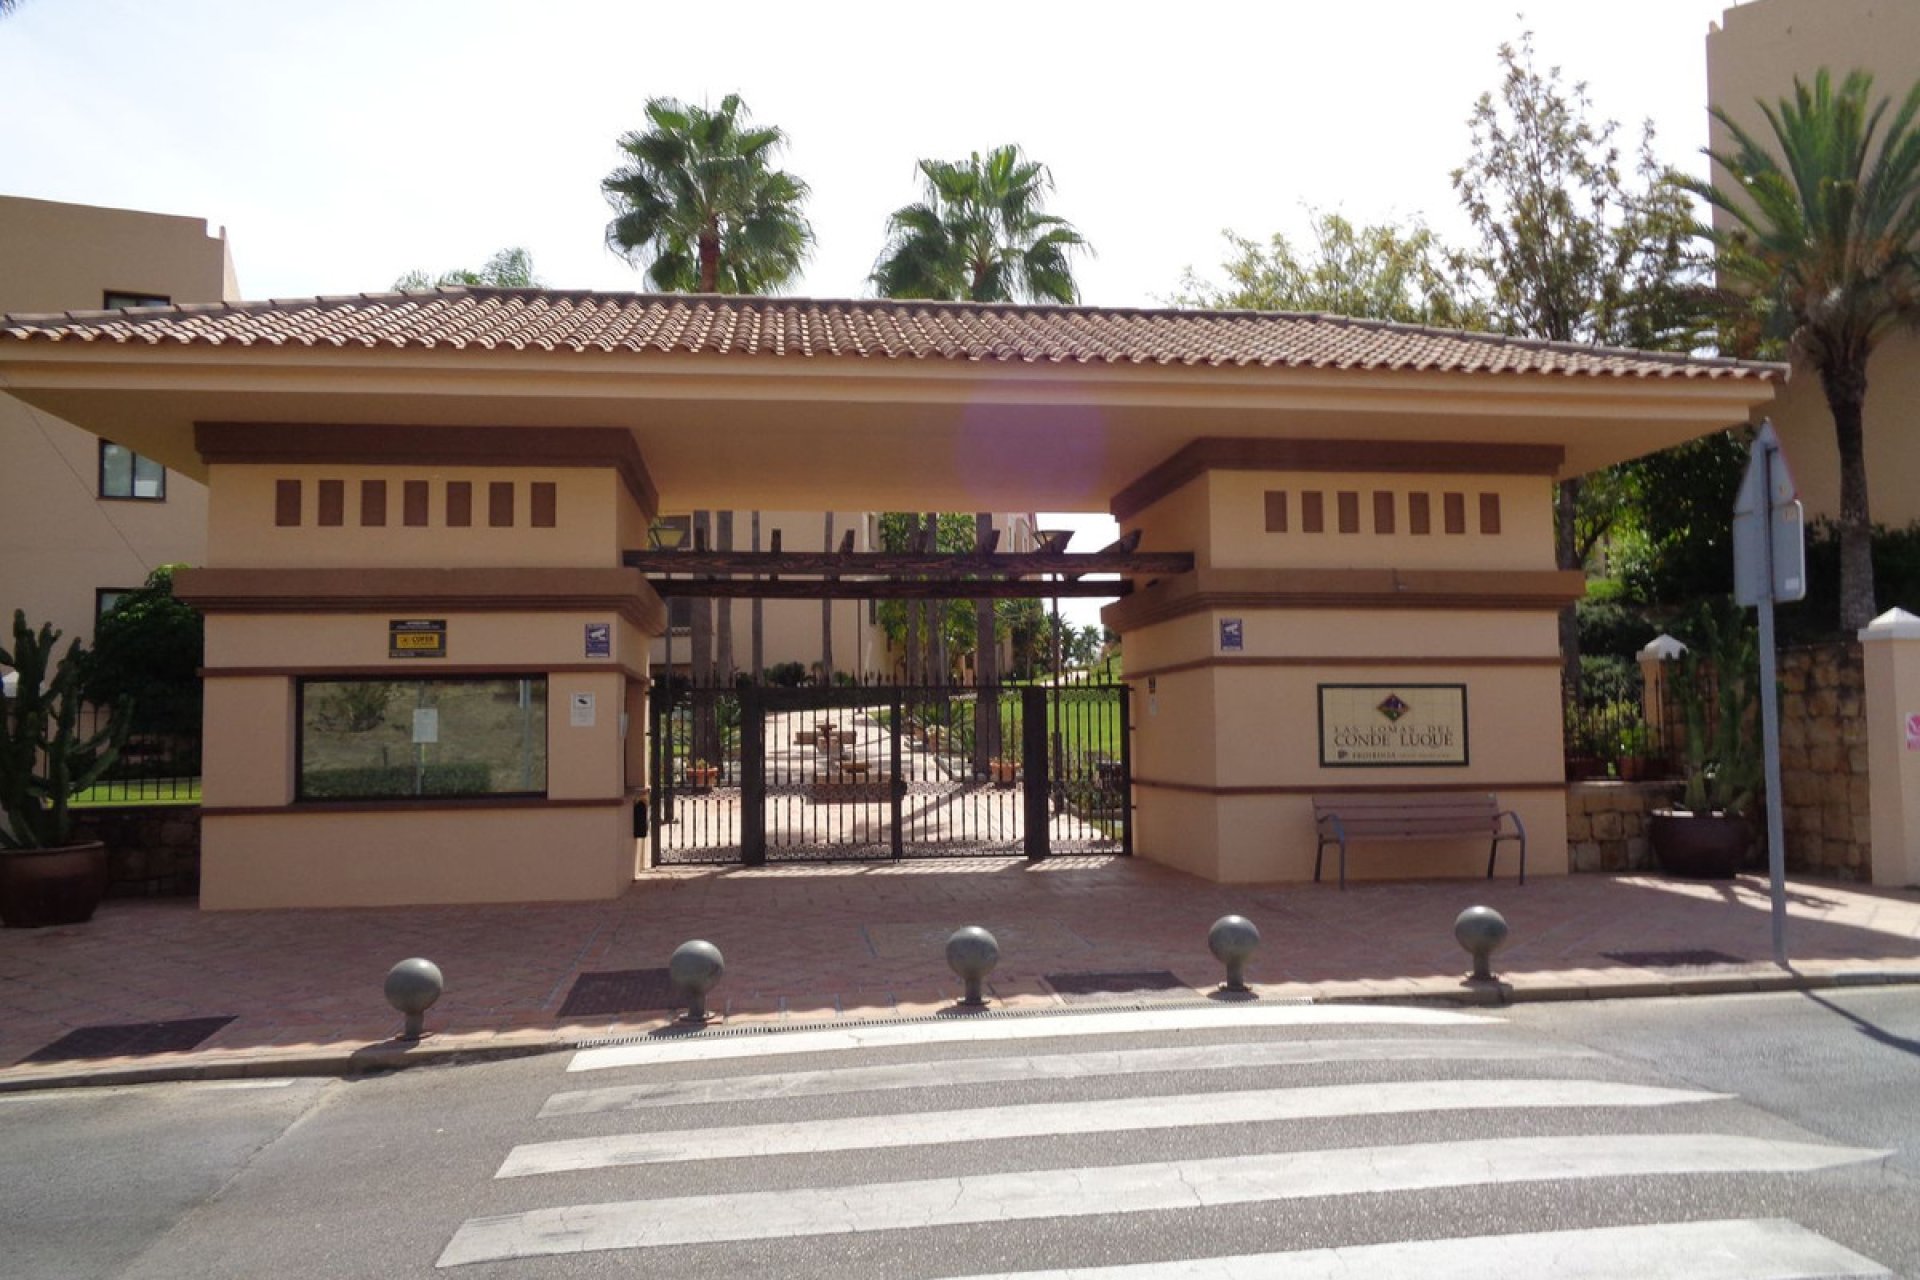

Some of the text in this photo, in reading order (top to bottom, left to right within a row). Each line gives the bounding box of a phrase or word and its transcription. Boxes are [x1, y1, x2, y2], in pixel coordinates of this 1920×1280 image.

[1334, 725, 1360, 733] LAS
[1370, 725, 1416, 733] LOMAS
[1334, 733, 1453, 748] CONDE LUQUE
